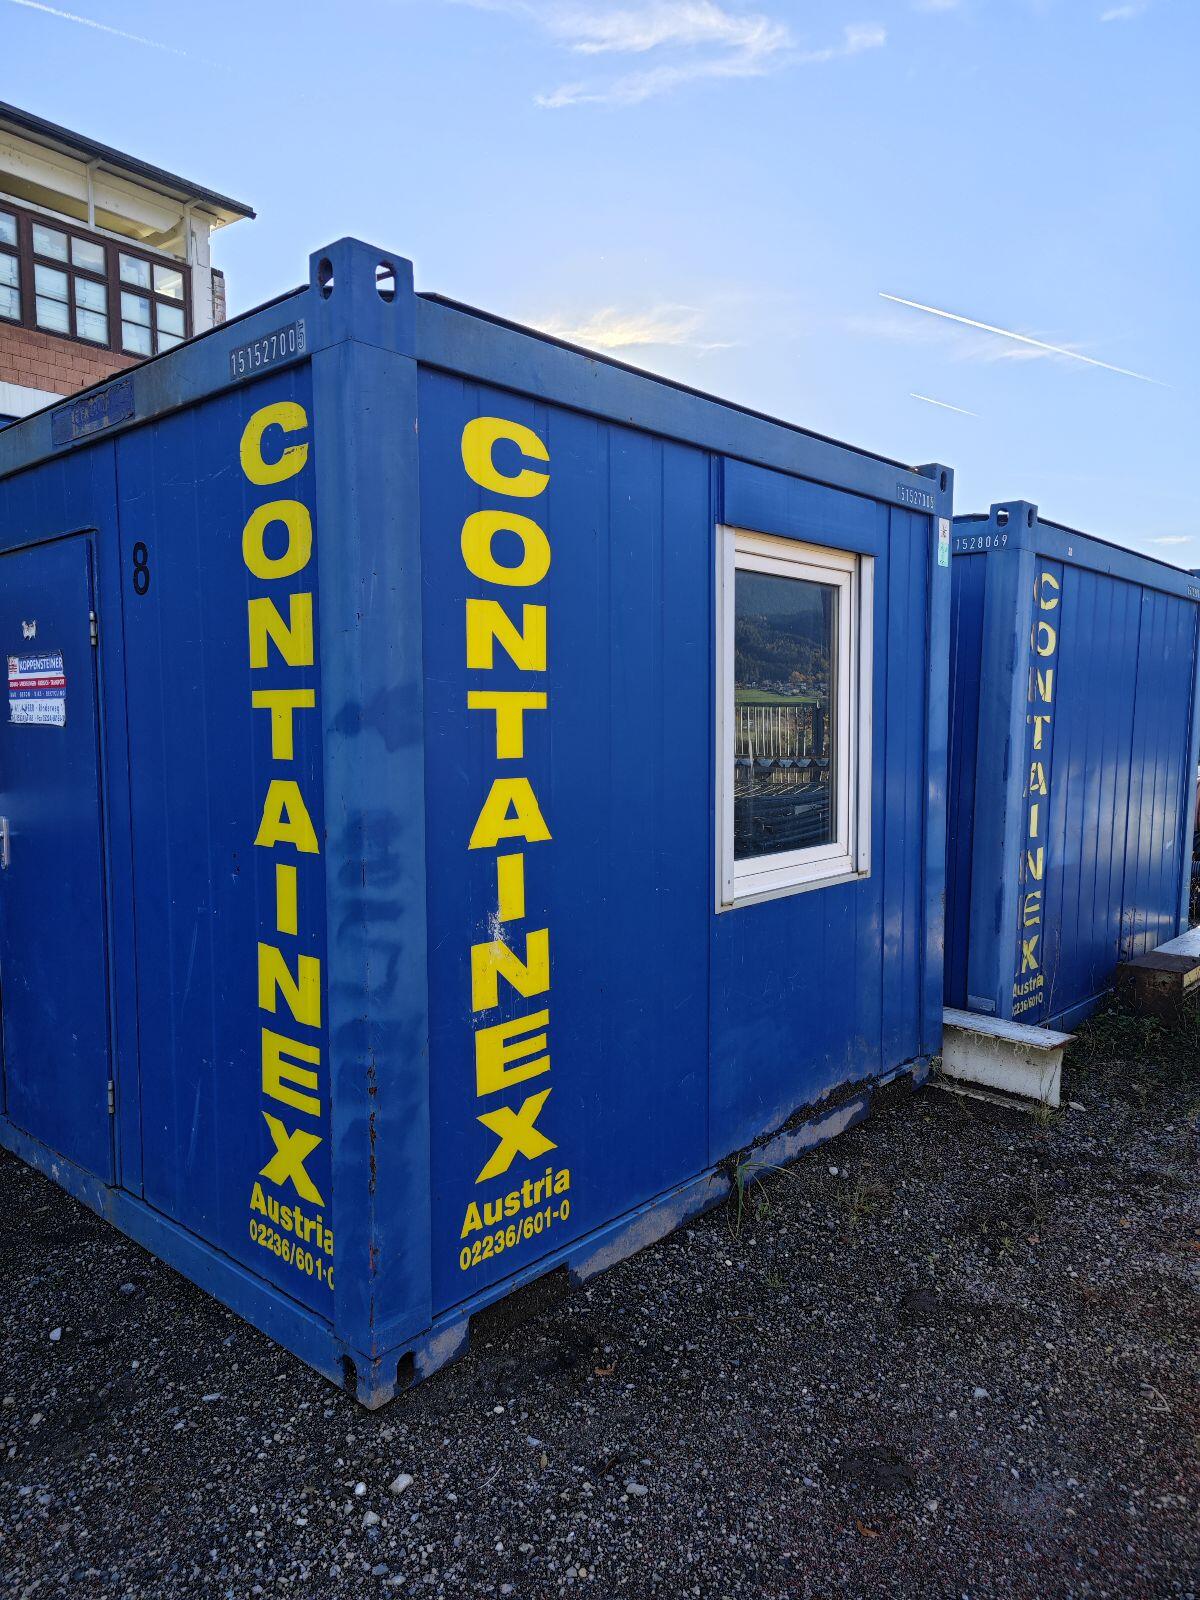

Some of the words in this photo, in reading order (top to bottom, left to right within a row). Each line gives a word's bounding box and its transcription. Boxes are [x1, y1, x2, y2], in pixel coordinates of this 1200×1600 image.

[231, 328, 305, 376] 151527005
[132, 541, 150, 596] 8
[19, 657, 63, 671] KOPPENSTEINER
[239, 400, 327, 1208] CONTAINEX
[460, 415, 559, 1185] CONTAINEX
[1013, 572, 1061, 978] CONTAINEX
[1012, 973, 1044, 999] Austria
[249, 1181, 334, 1257] Austria
[458, 1199, 570, 1271] 02236/601-0
[459, 1166, 570, 1240] Austria
